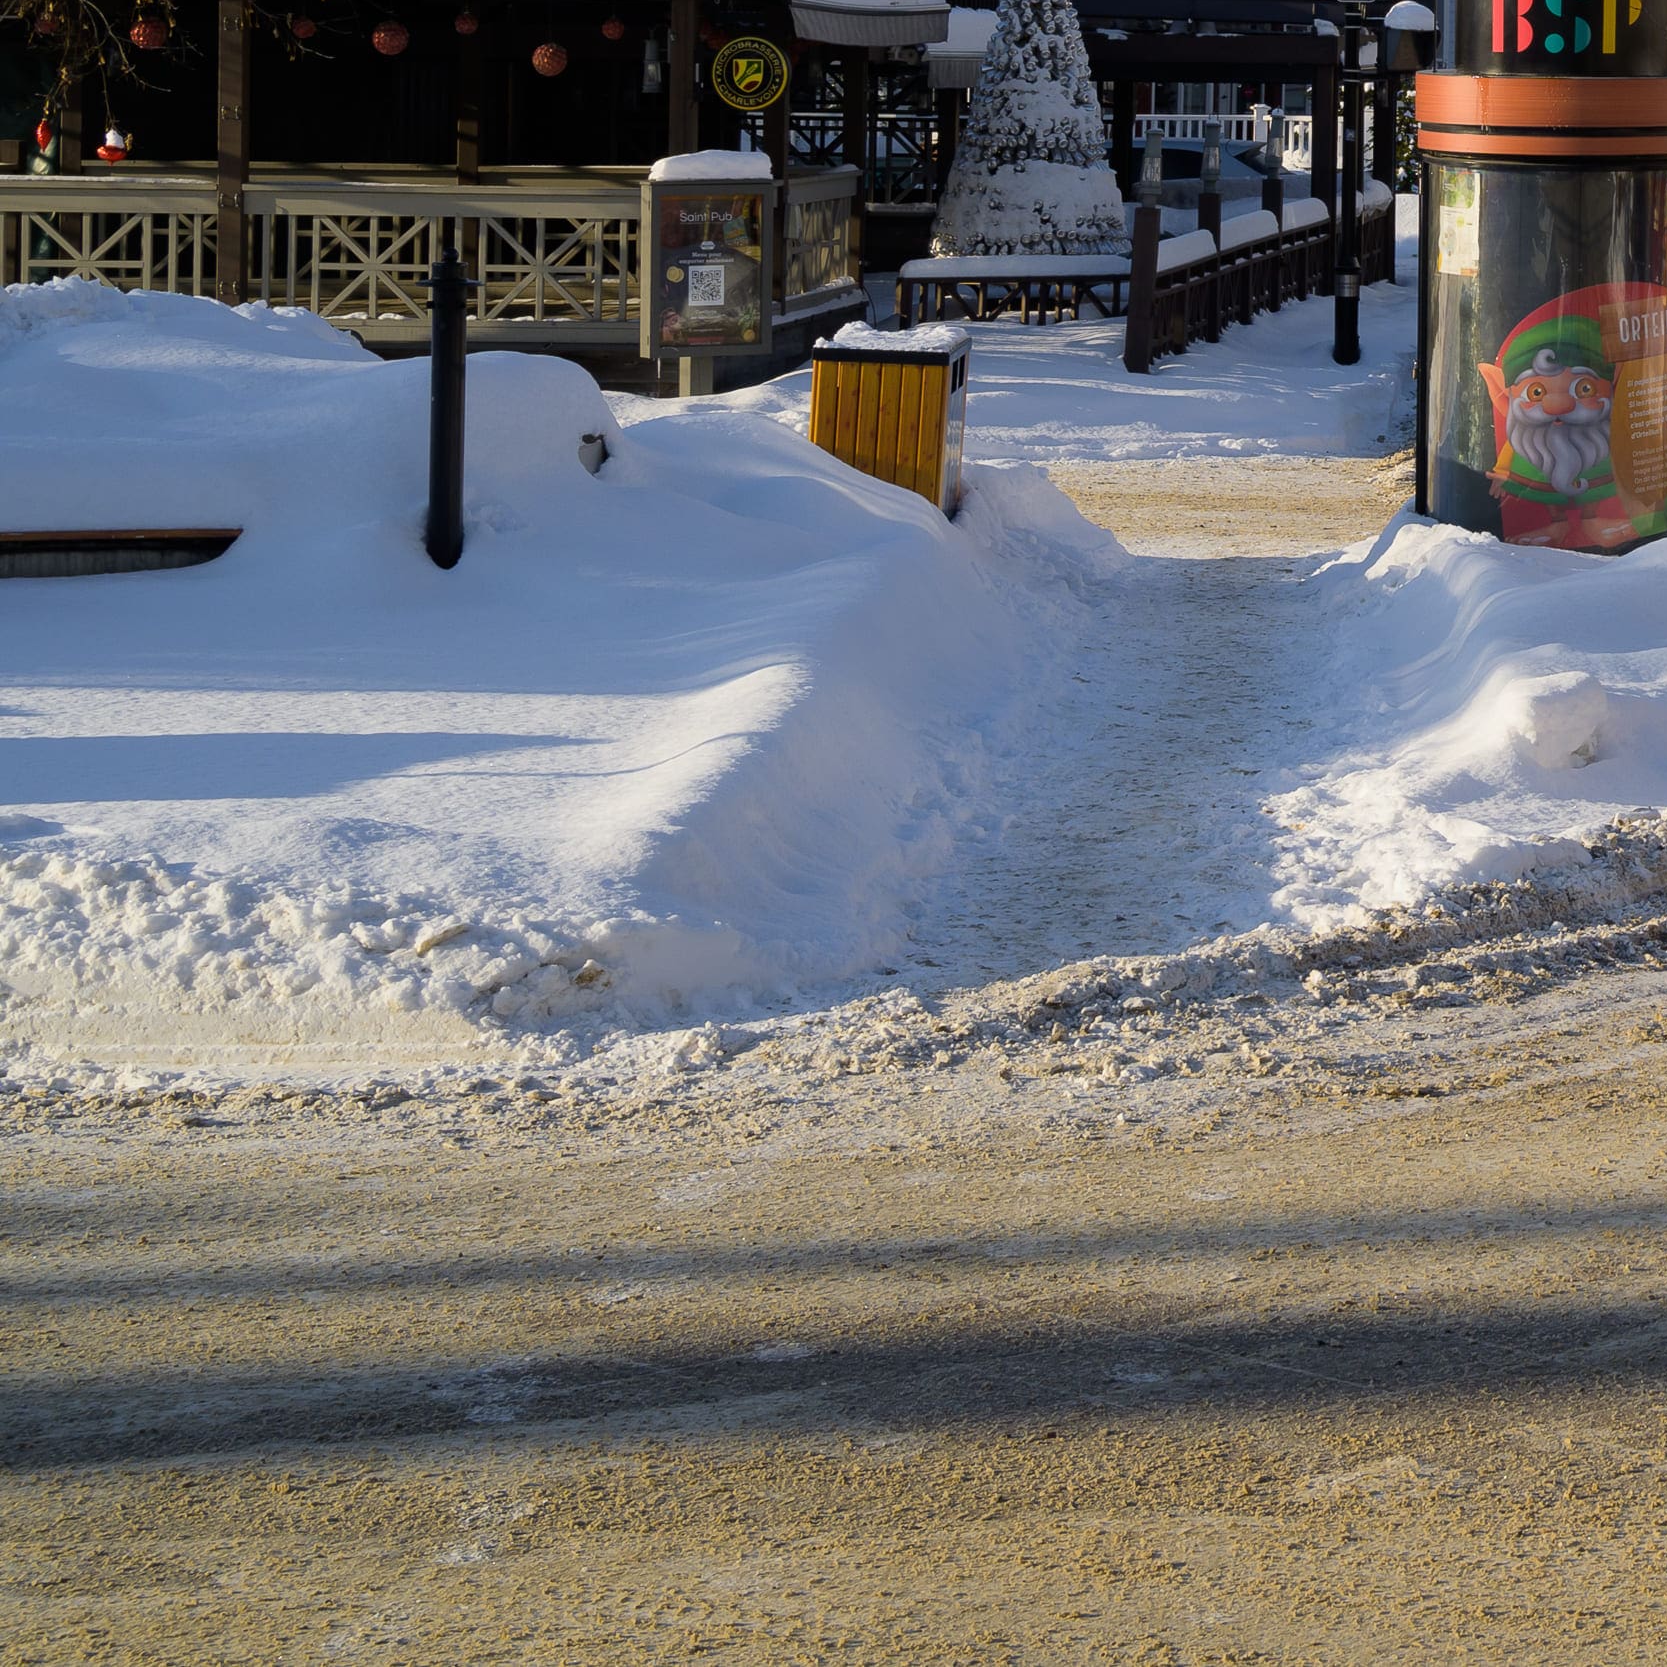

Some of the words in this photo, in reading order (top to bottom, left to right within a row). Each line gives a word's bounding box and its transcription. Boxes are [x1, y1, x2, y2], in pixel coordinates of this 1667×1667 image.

[716, 41, 782, 75] MICROBRASSERIE
[719, 83, 779, 106] CHARLEVOIX
[679, 211, 708, 223] Saint
[711, 210, 733, 222] Pub
